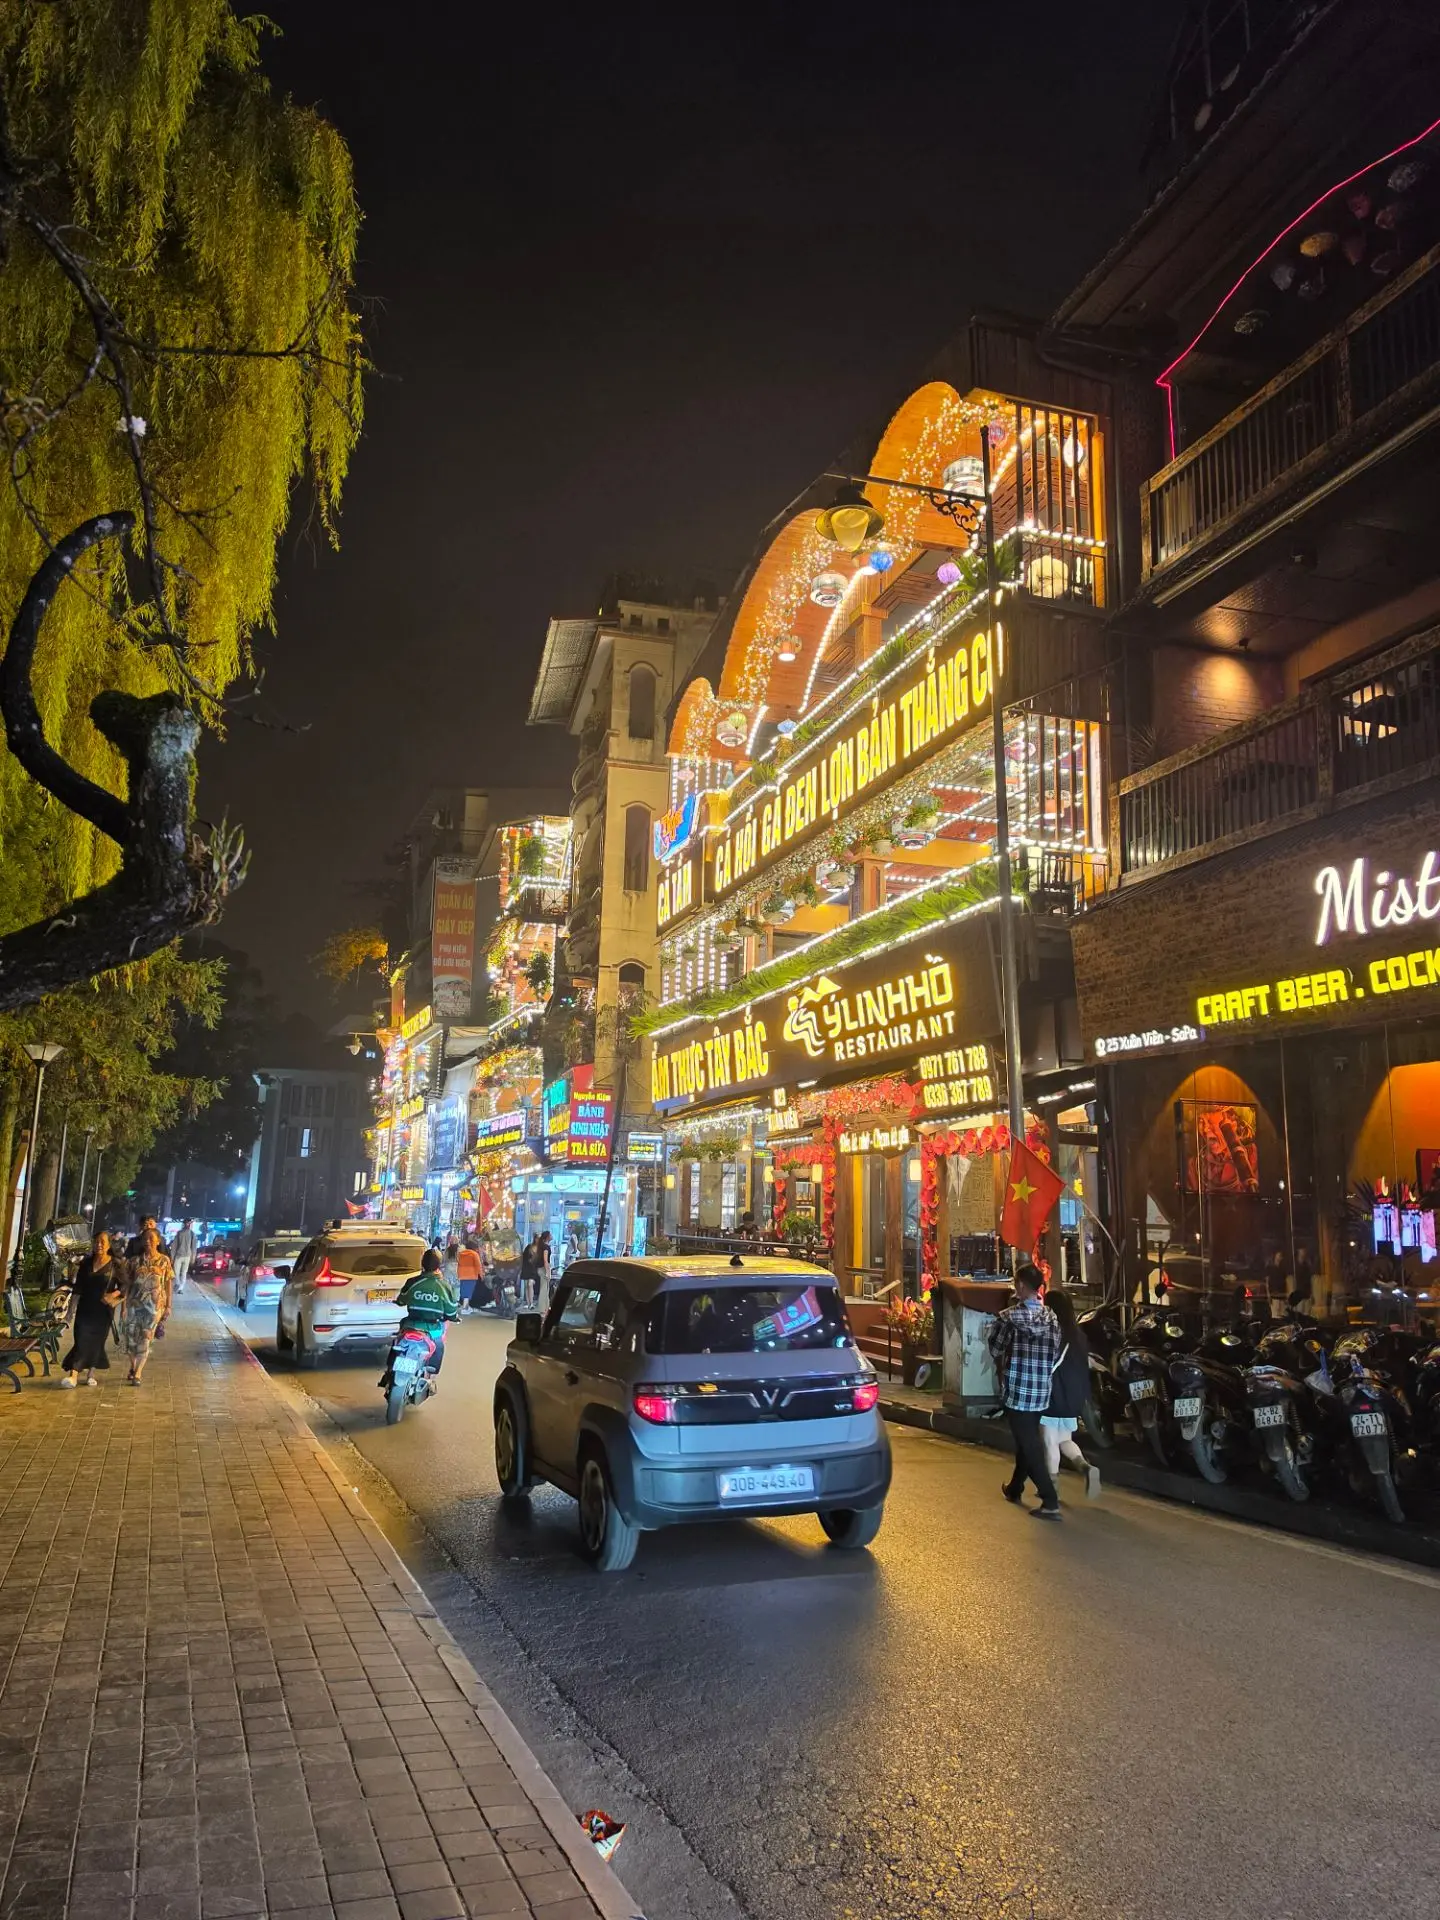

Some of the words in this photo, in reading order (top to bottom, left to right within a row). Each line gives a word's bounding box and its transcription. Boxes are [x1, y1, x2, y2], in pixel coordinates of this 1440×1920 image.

[715, 828, 731, 893] CÁ
[734, 802, 758, 880] HỒI
[761, 786, 782, 857] GÀ
[784, 768, 817, 840] ĐEN
[821, 737, 854, 820] LỢN
[857, 696, 896, 790] BẢN
[1197, 984, 1270, 1026] CRAFT
[1276, 969, 1348, 1012] BEER
[834, 1010, 955, 1061] RESTAURANT
[1106, 1036, 1119, 1052] 25
[671, 1039, 705, 1103] THỰC
[705, 1025, 731, 1089] TÂY
[733, 1005, 769, 1082] BẮC
[919, 1054, 944, 1079] 0971
[944, 1049, 965, 1075] 761
[970, 1075, 992, 1102] 789
[578, 1102, 604, 1118] BÁNH
[571, 1139, 588, 1156] TRÀ
[589, 1139, 607, 1157] SỮA
[414, 1290, 439, 1303] Grab
